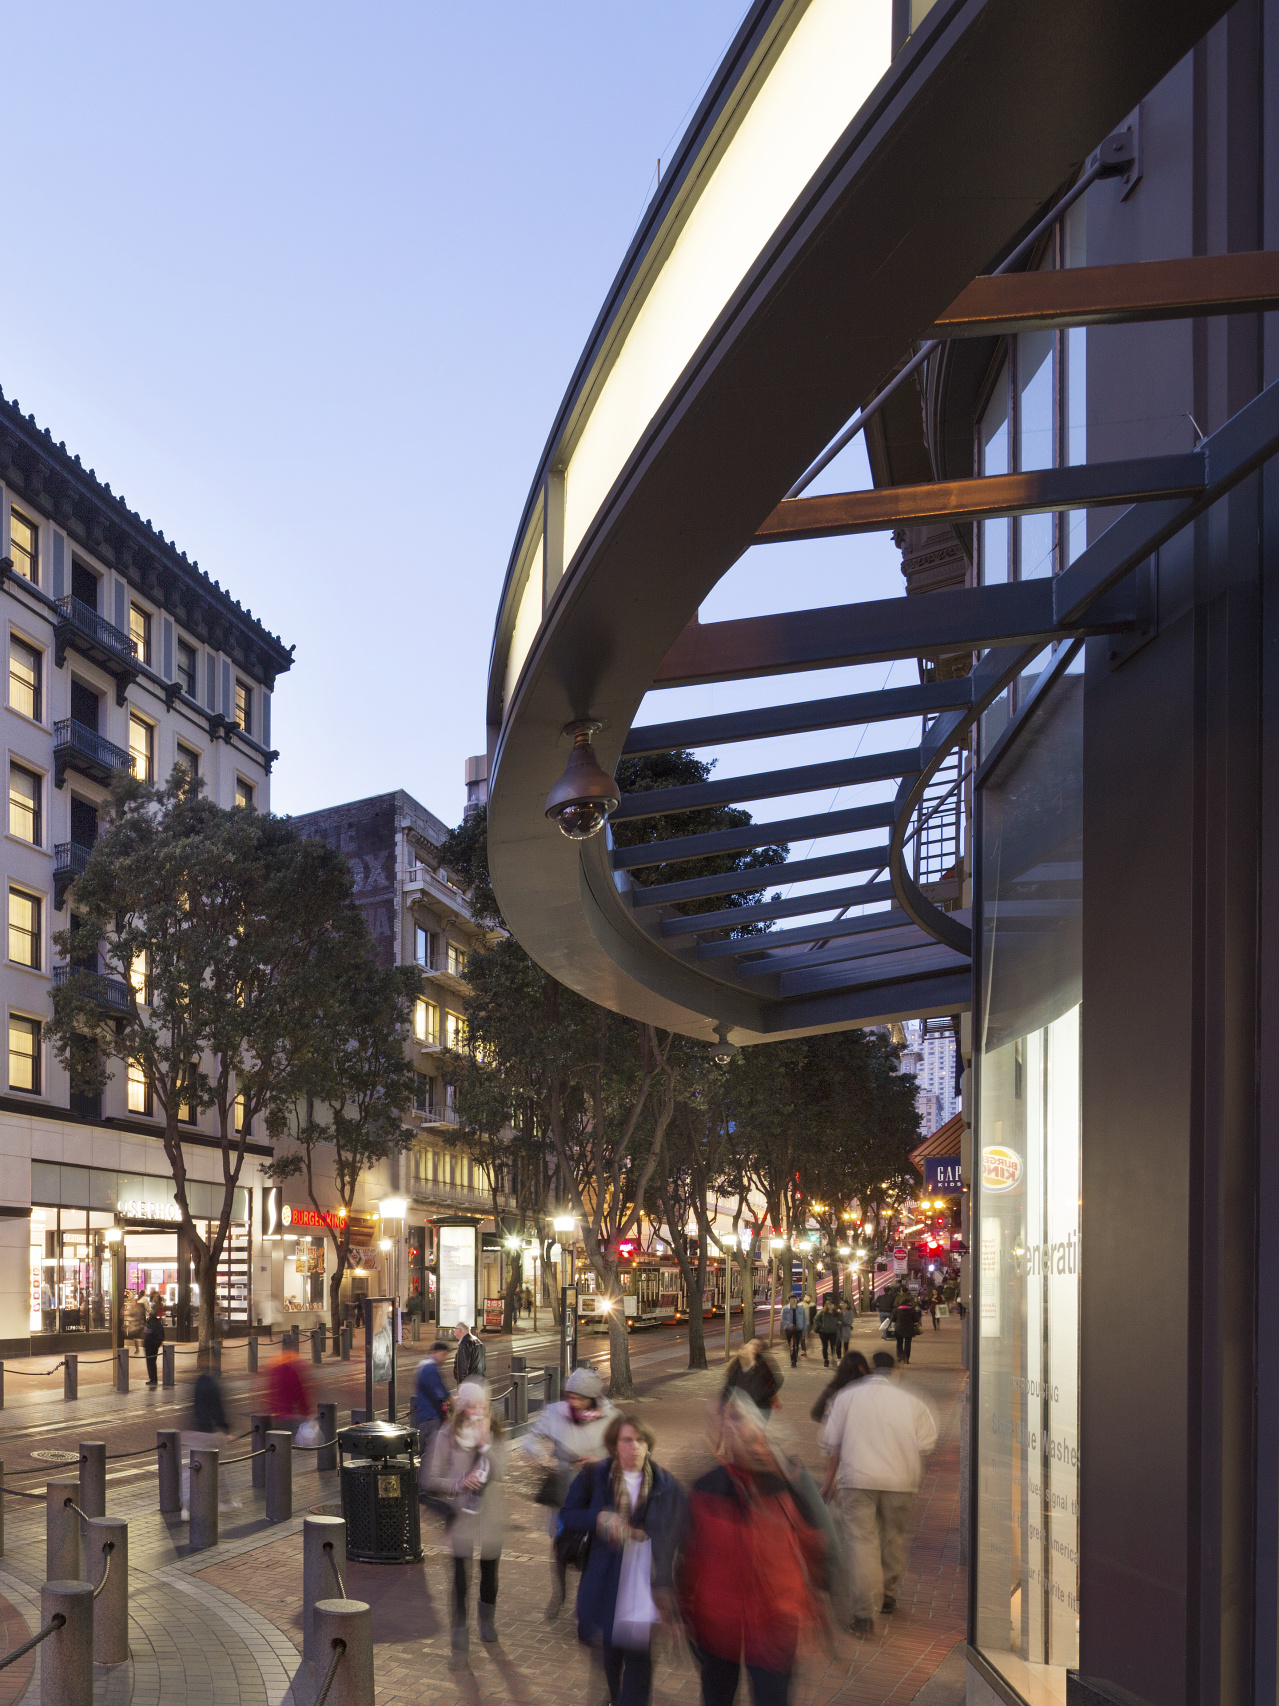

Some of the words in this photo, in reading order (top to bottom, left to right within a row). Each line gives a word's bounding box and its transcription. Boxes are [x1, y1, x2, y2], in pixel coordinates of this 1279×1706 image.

[937, 1165, 962, 1182] GAP
[128, 1200, 183, 1221] SEPHOR
[325, 1212, 346, 1230] KING
[1014, 1229, 1080, 1277] Generati
[1045, 1488, 1068, 1512] sgnal
